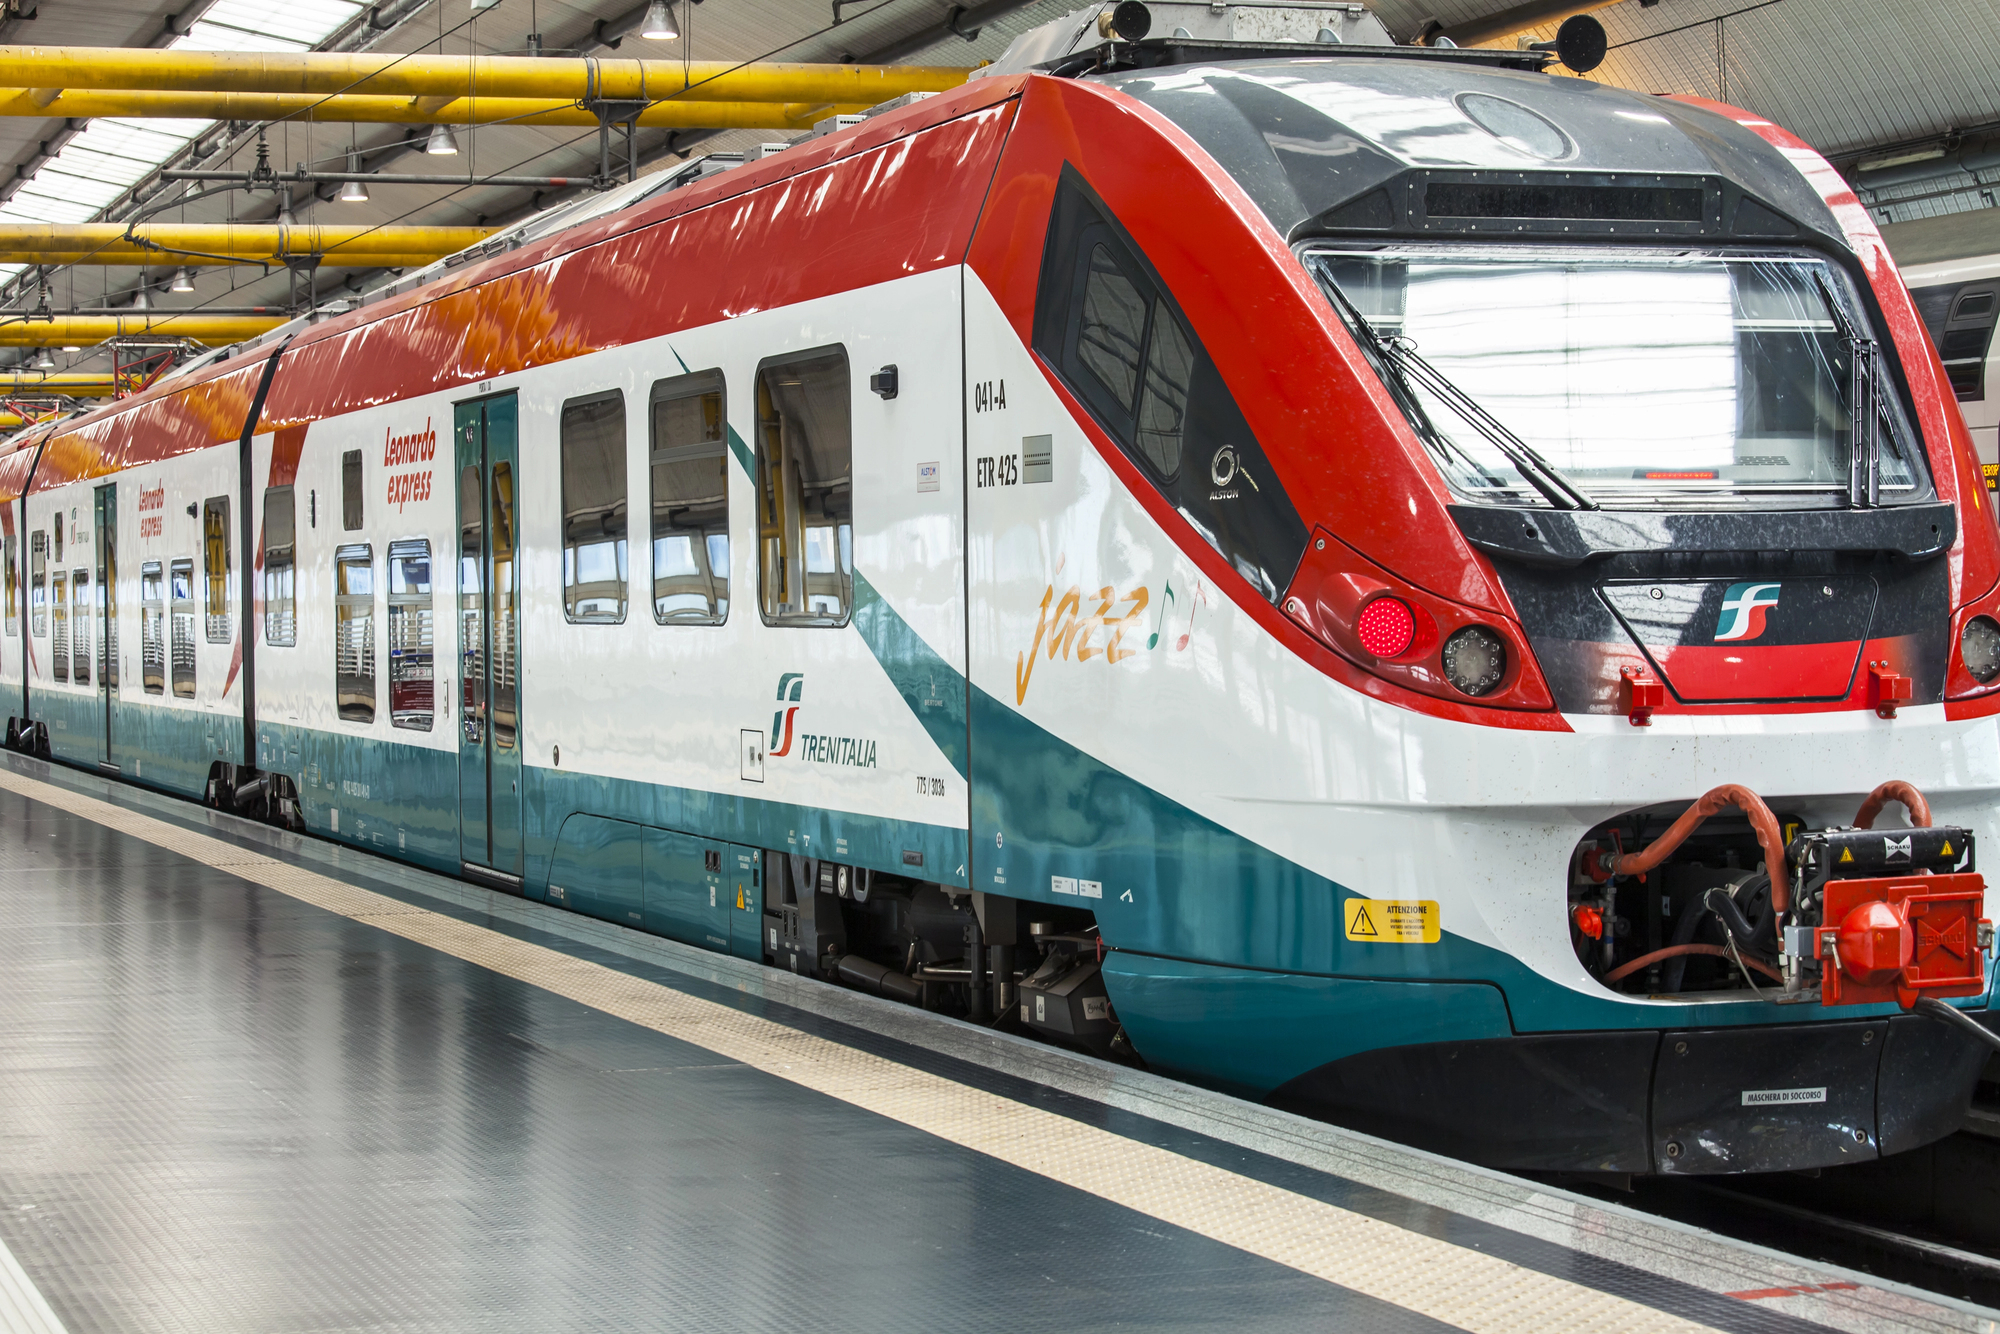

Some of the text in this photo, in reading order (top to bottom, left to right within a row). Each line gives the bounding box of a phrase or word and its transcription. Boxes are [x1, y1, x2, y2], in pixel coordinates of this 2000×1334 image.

[975, 379, 1006, 413] 041-A
[384, 416, 436, 467] Leonardo
[977, 454, 1017, 488] ETR 425
[139, 478, 164, 512] Leonardo
[387, 470, 432, 514] express
[1209, 489, 1239, 500] ALSTOM
[140, 515, 163, 545] express
[801, 734, 876, 768] TRENITALIA
[916, 776, 926, 794] 775
[931, 777, 945, 796] 3036
[1386, 905, 1427, 914] ATTENZIONE
[1748, 1091, 1821, 1102] MASCHERA DI SOCCORSO
